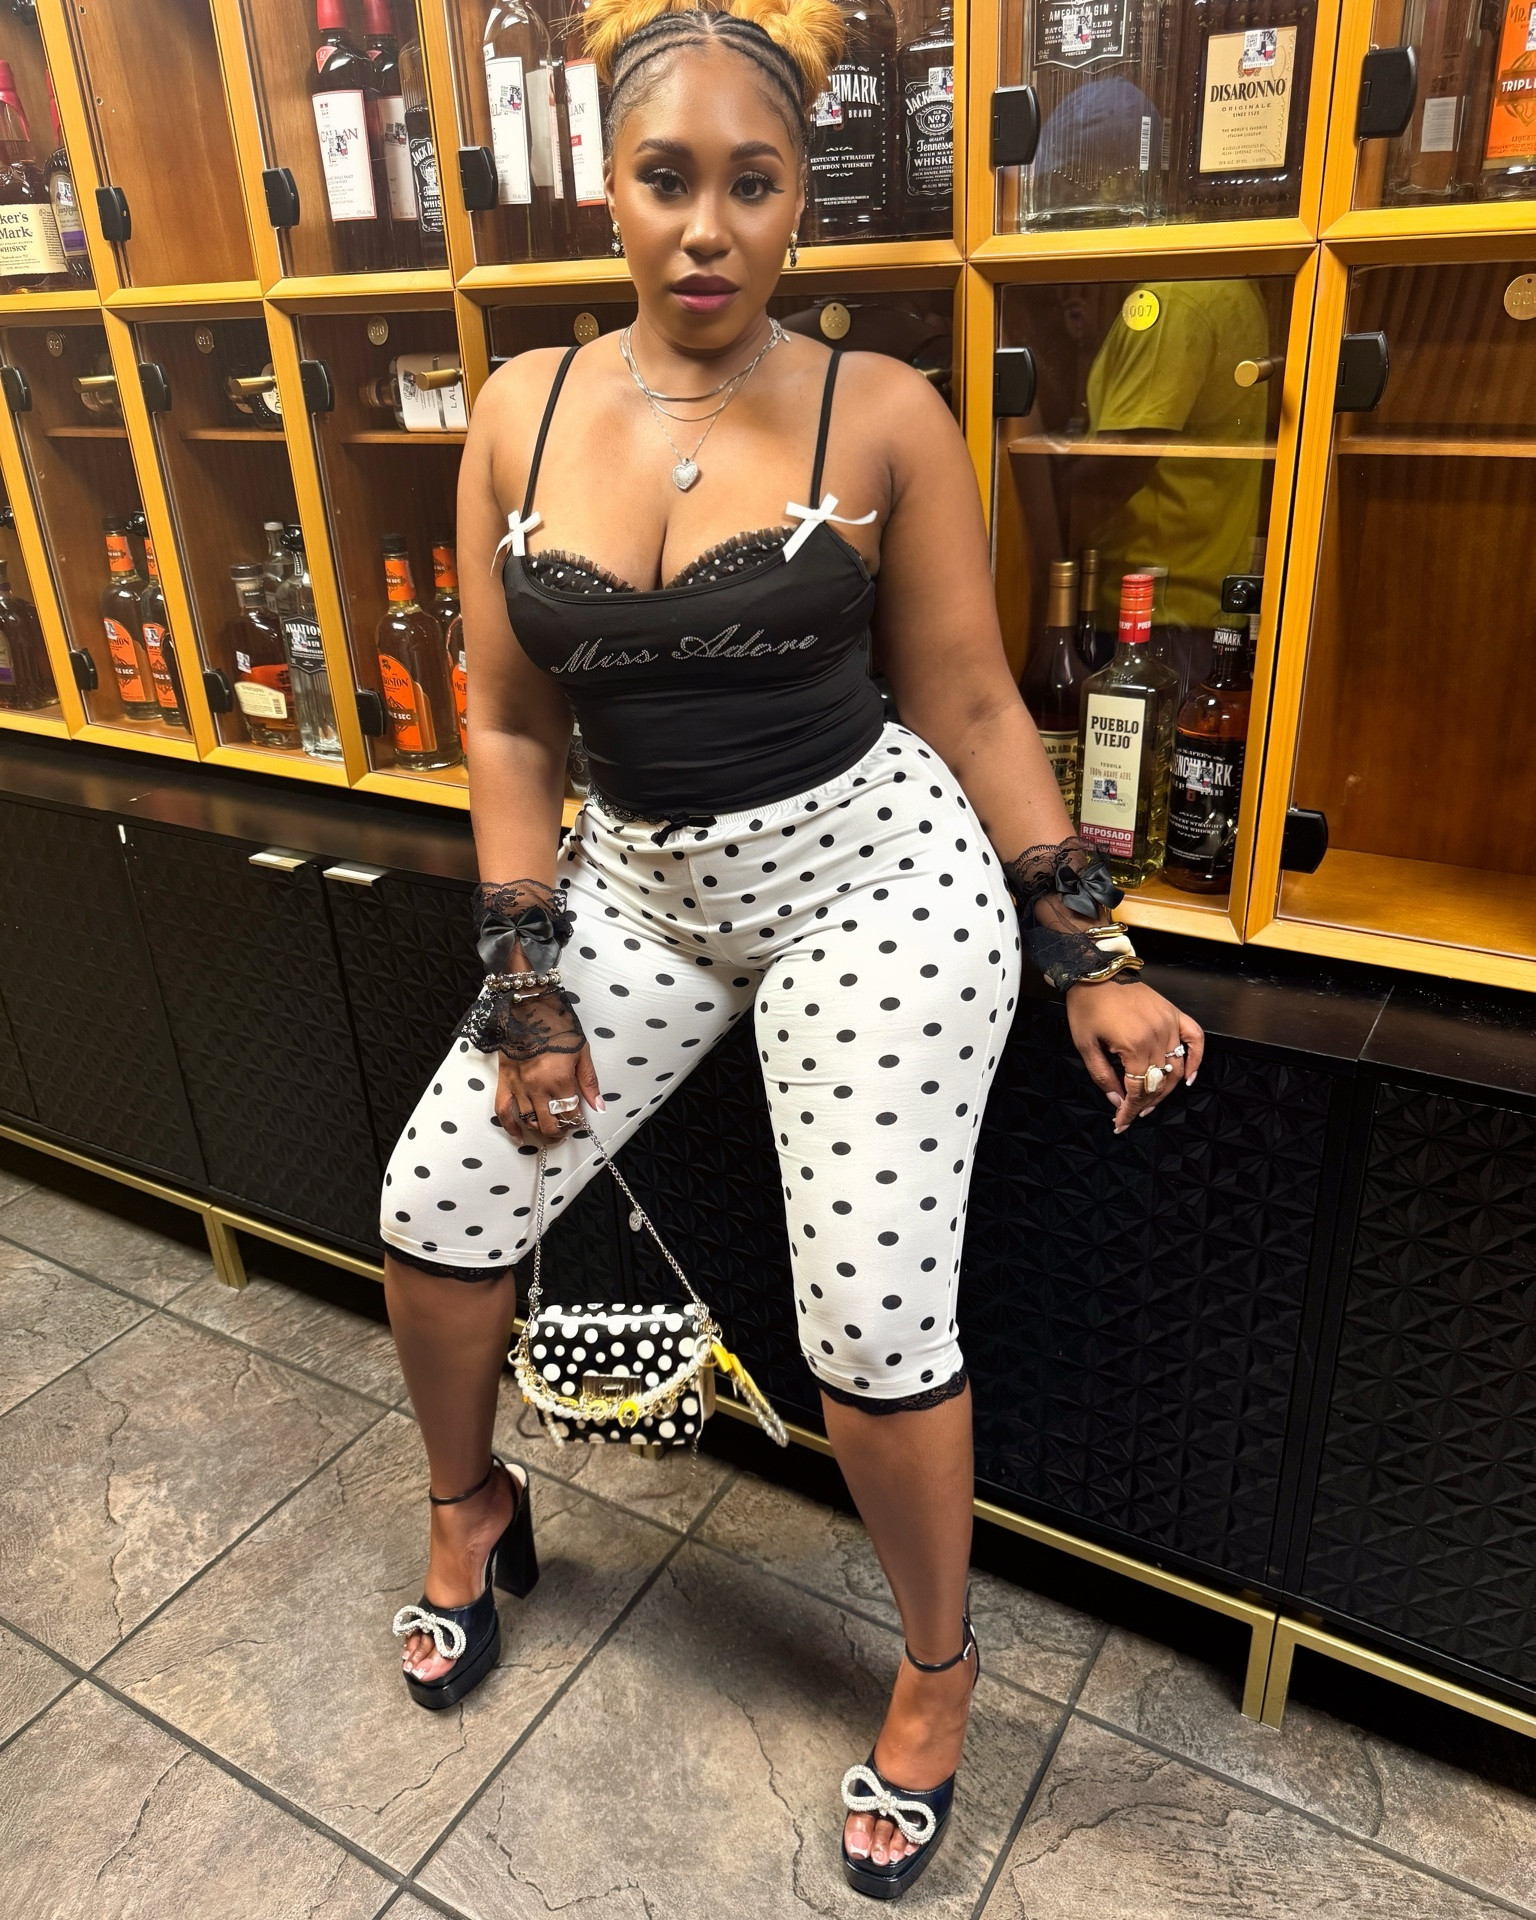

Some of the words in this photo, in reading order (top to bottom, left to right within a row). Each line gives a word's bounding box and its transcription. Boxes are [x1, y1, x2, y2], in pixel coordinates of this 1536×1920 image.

[1049, 7, 1092, 21] AMERICAN
[1094, 4, 1109, 15] GIN
[1044, 26, 1063, 34] BATC
[1091, 20, 1113, 28] LLED
[1261, 30, 1275, 41] TX
[827, 73, 879, 106] HMARK
[1210, 79, 1287, 103] DISARONNO
[905, 90, 930, 116] JACK
[1221, 103, 1272, 112] ORIGINALE
[848, 109, 872, 118] BRAND
[411, 144, 428, 167] JACK
[810, 155, 839, 163] KENTUCKY
[811, 163, 840, 171] BOURBON
[841, 161, 873, 169] WHISKEY
[1129, 305, 1153, 317] 007
[550, 637, 659, 674] Miss
[671, 623, 818, 660] Adore
[1090, 716, 1139, 734] PUEBLO
[1094, 732, 1131, 749] VIEJO
[1104, 769, 1118, 778] AGAVE
[1119, 771, 1131, 781] AZUL
[1172, 754, 1233, 787] ENCHRK
[1083, 825, 1131, 841] REPOSADO
